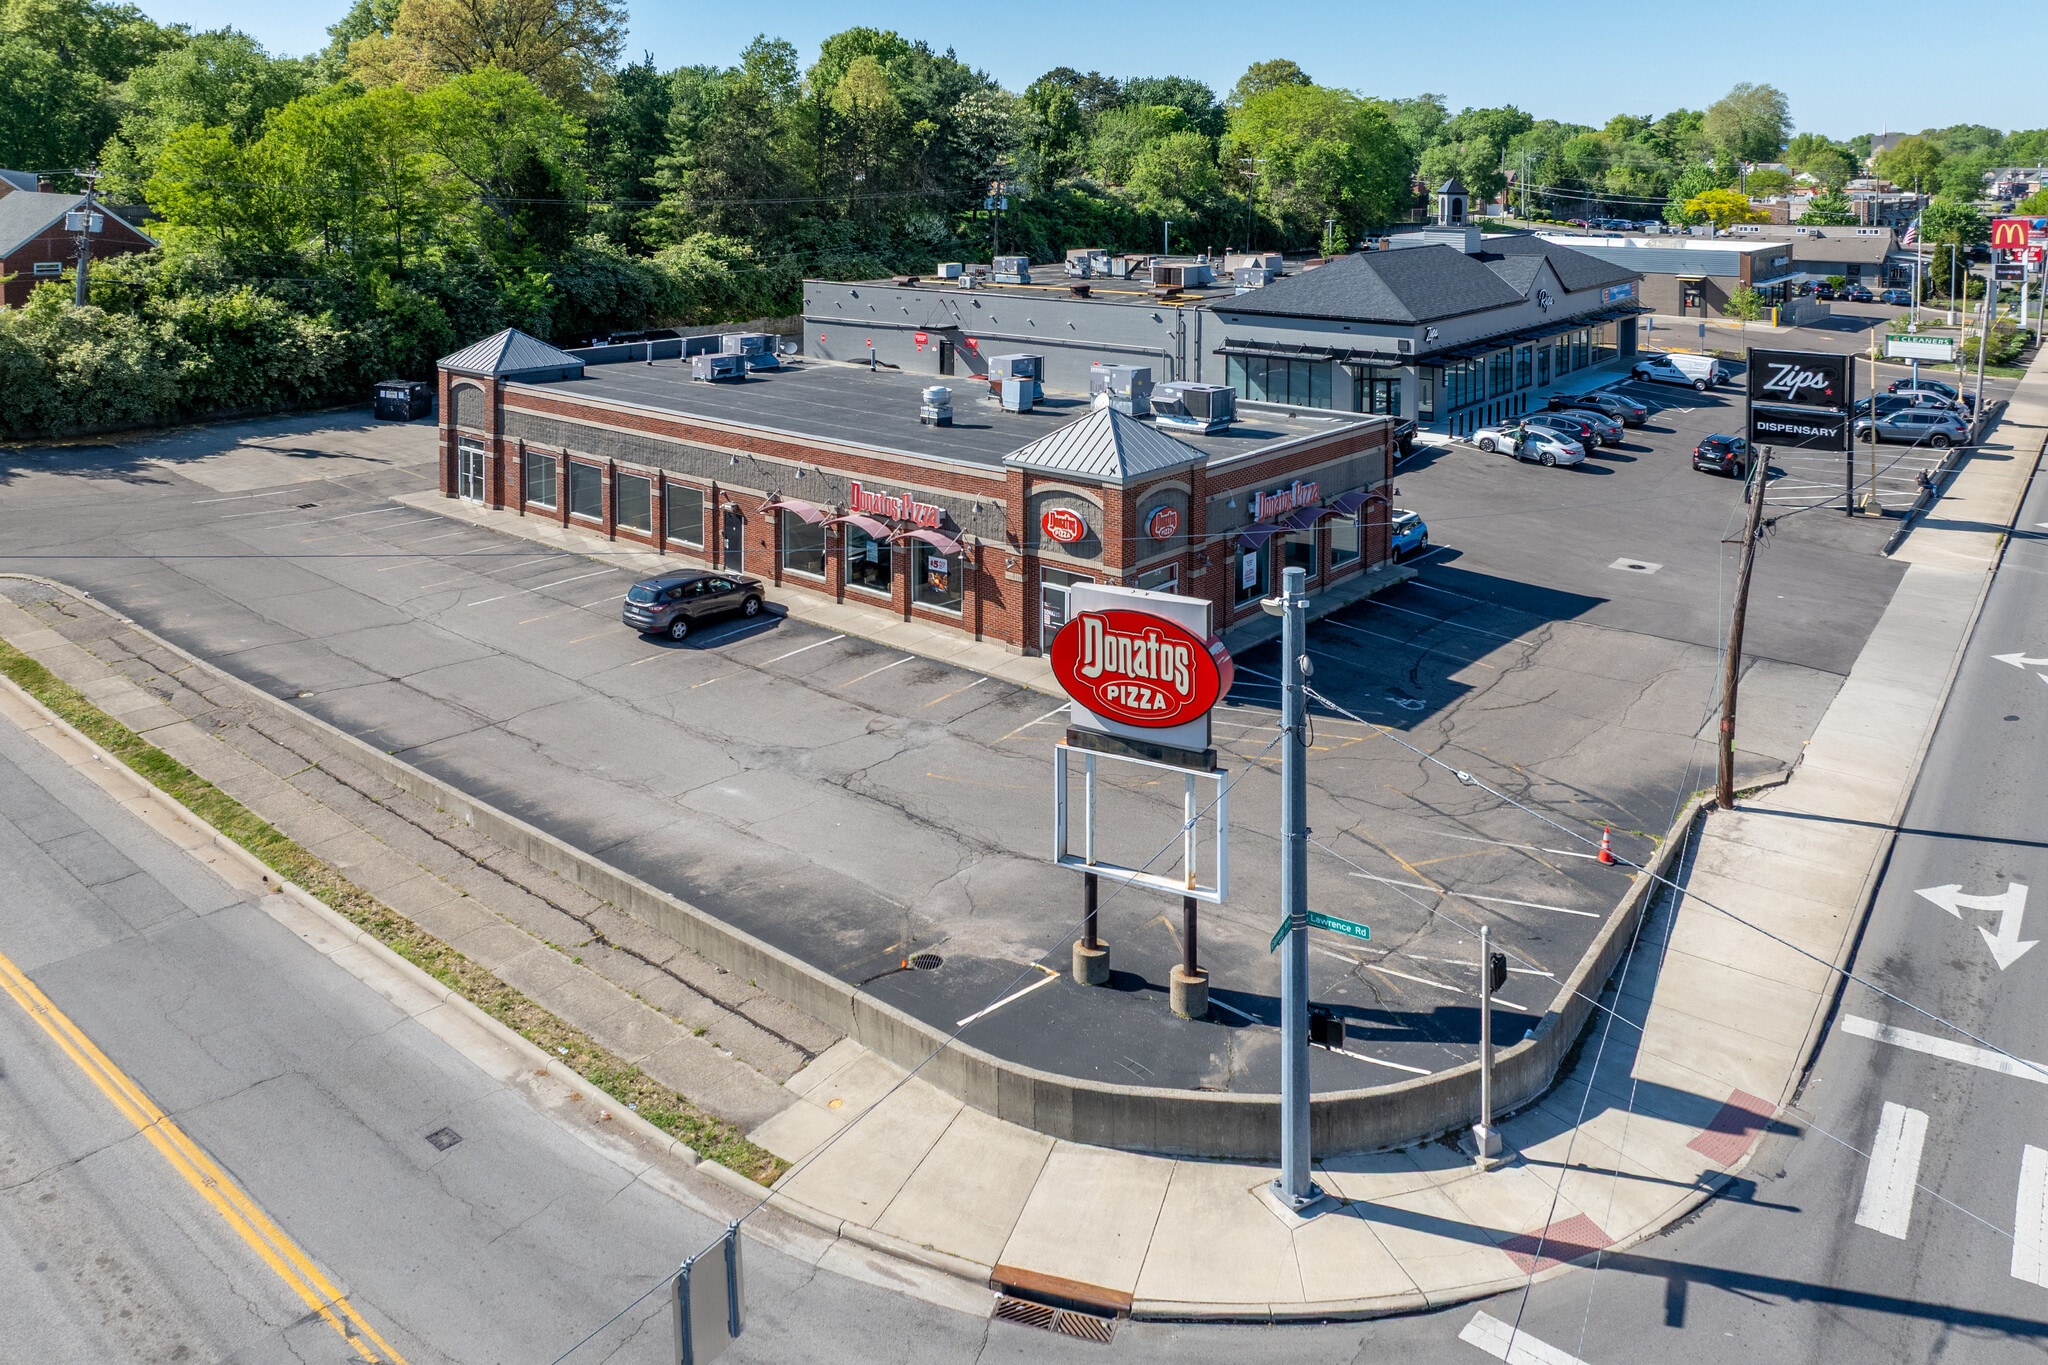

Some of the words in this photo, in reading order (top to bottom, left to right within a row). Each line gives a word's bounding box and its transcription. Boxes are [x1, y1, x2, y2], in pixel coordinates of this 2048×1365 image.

[1901, 336, 1949, 345] CLEANERS
[1763, 362, 1829, 400] Zips
[1756, 421, 1838, 437] DISPENSARY
[851, 481, 901, 521] Donatos
[901, 493, 941, 529] Pizza
[1255, 492, 1293, 524] Donatos
[1294, 480, 1320, 508] Pizza
[1054, 529, 1071, 538] PIZZA
[1081, 617, 1189, 696] Donatos
[1107, 685, 1167, 710] PIZZA
[1310, 914, 1352, 932] Lawrence
[1355, 926, 1367, 937] Rd
